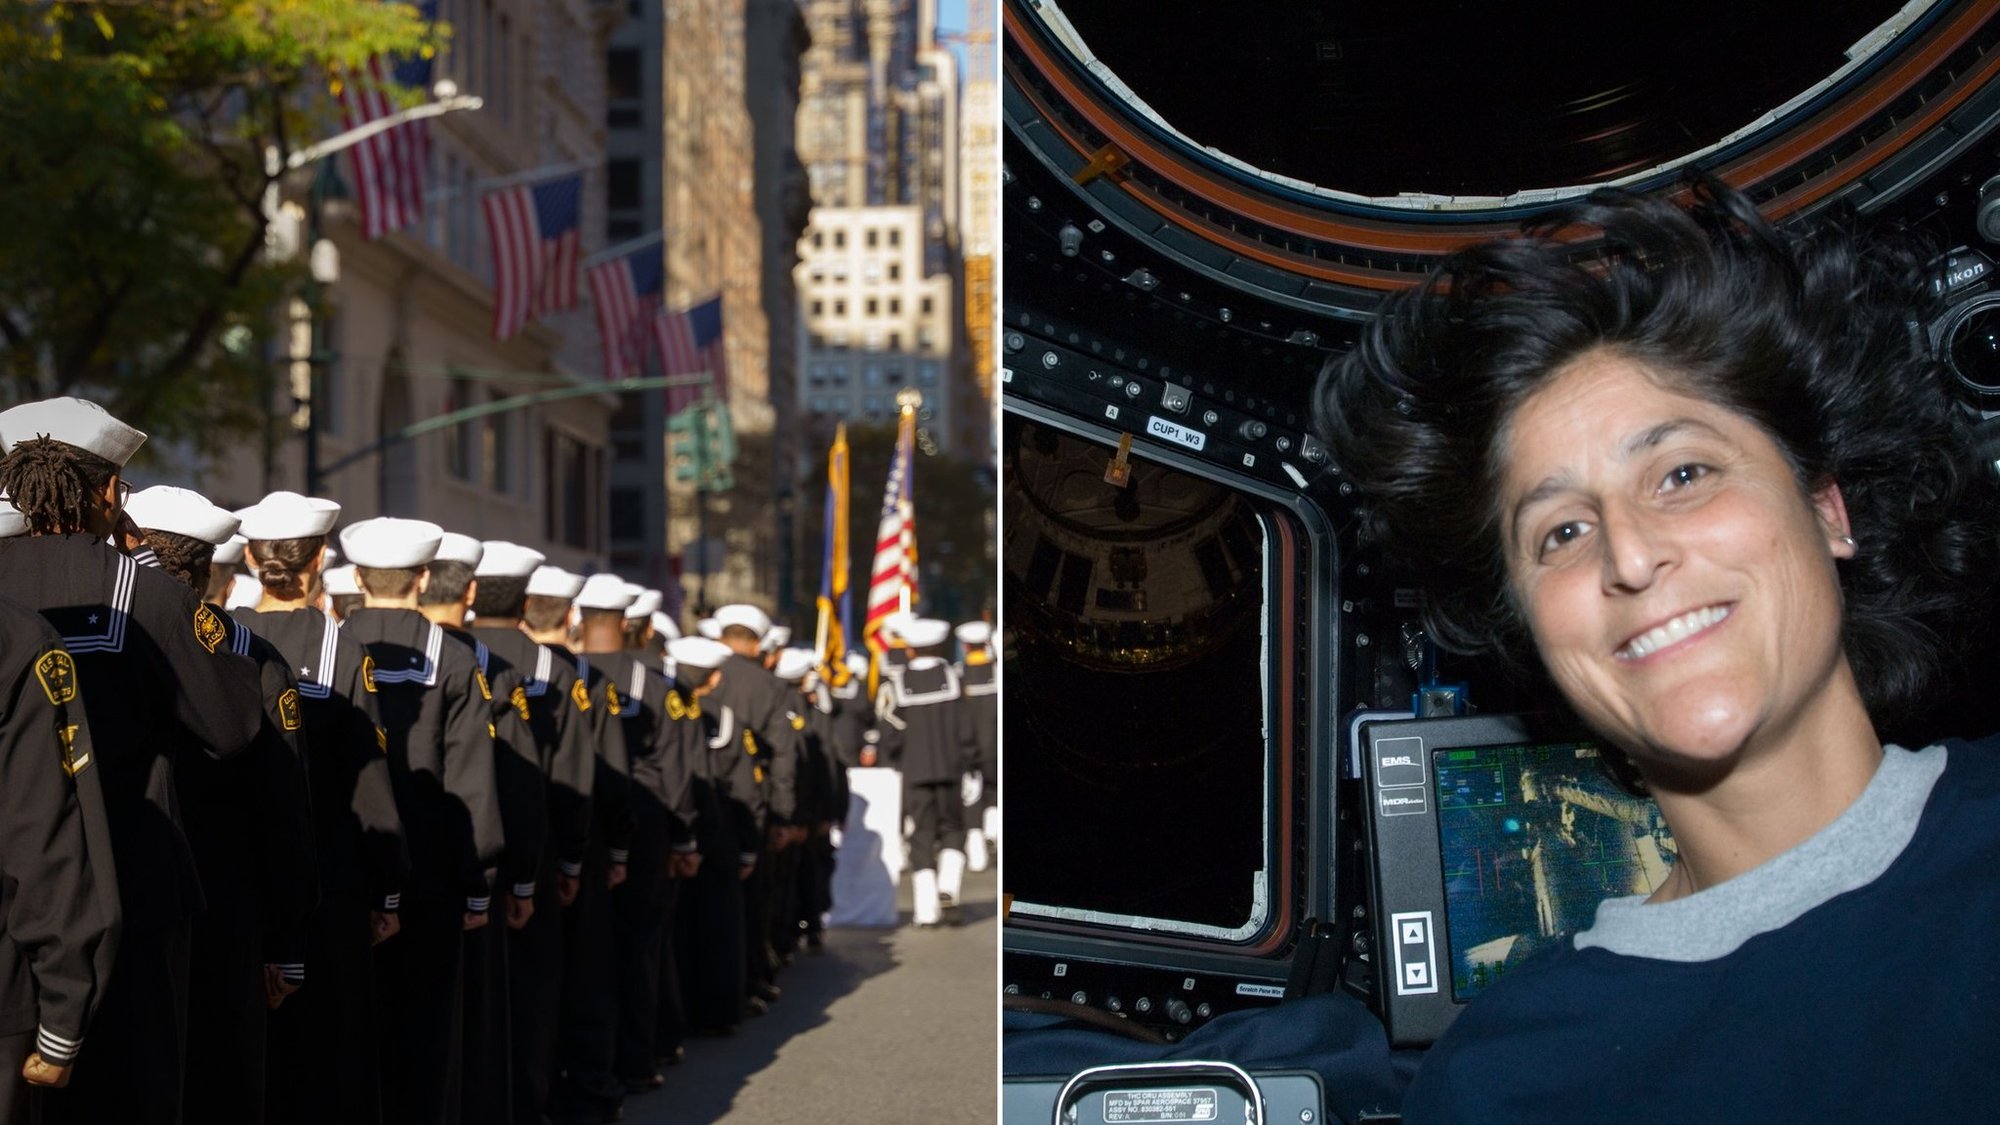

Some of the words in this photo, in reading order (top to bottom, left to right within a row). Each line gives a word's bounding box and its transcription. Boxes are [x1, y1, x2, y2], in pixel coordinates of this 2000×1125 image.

[1153, 421, 1200, 446] CUP1_W3
[1382, 756, 1411, 767] EMS
[1158, 1091, 1193, 1099] ASSEMBLY
[1151, 1097, 1192, 1106] AEROSPACE
